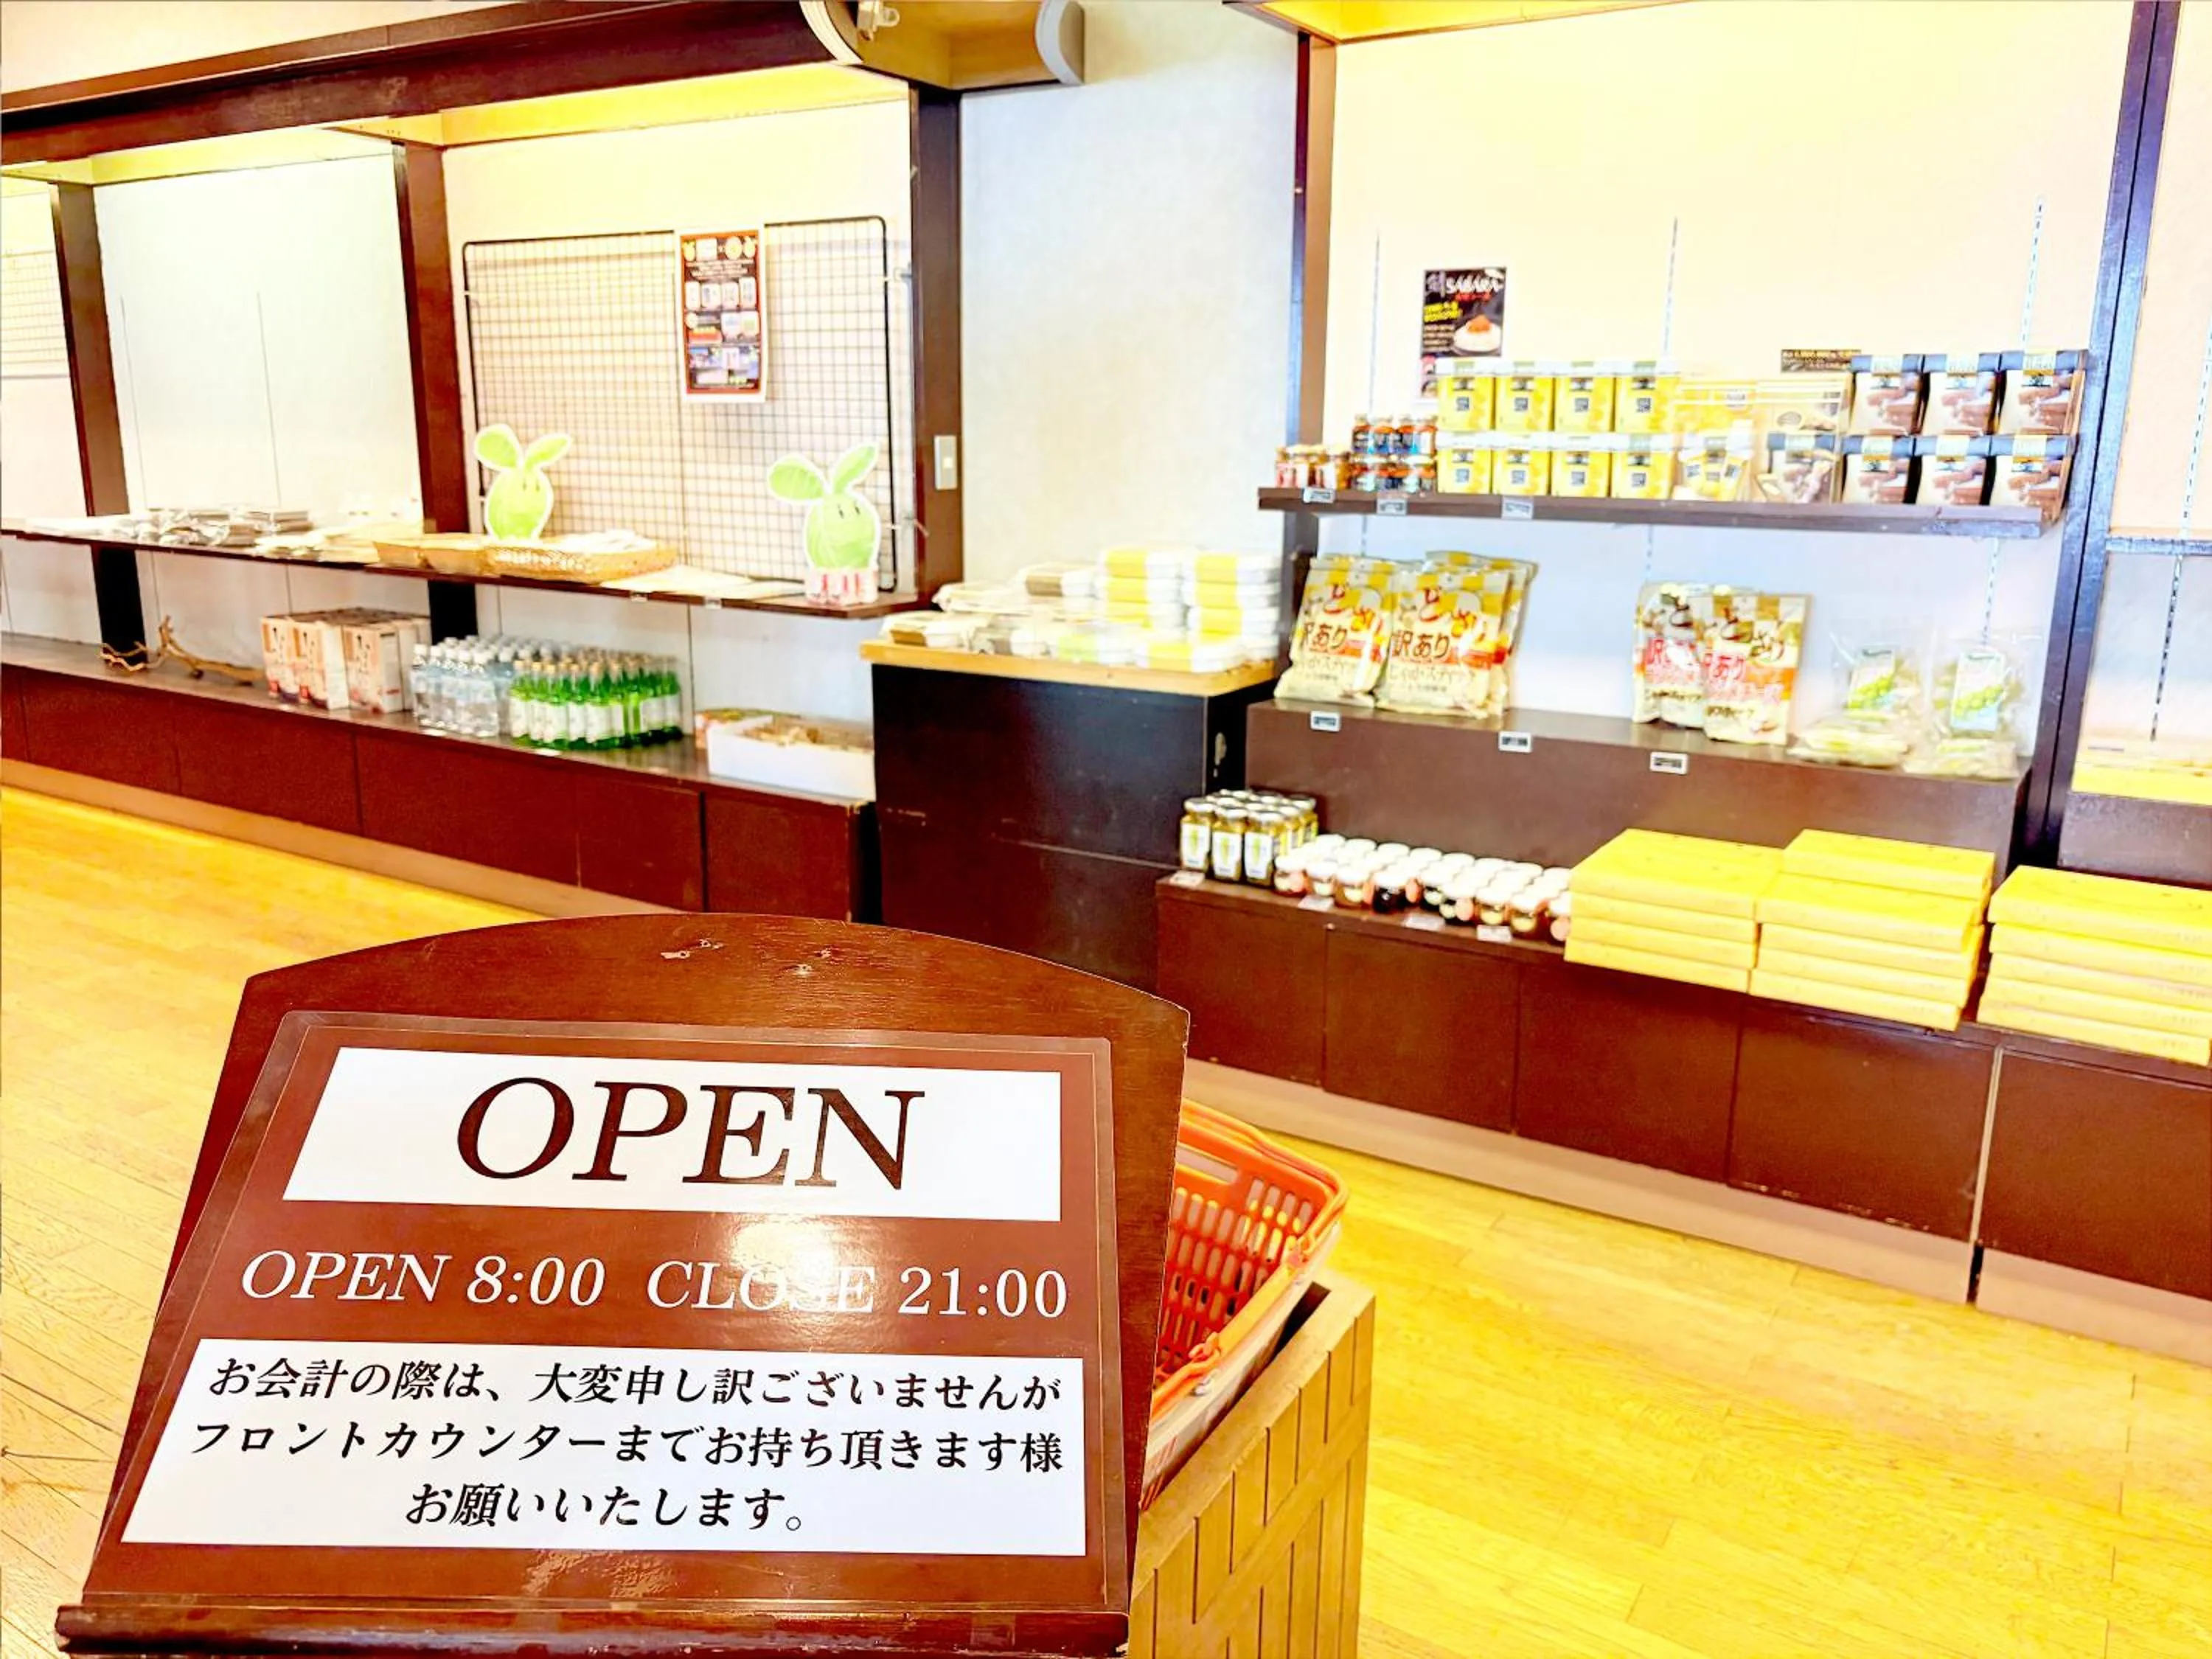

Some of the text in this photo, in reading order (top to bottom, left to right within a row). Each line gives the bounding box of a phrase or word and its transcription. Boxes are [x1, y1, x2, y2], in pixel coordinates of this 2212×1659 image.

[1391, 630, 1450, 658] 訳あり
[457, 1077, 925, 1189] OPEN
[241, 1250, 452, 1301] OPEN
[466, 1256, 605, 1306] 8:00
[898, 1266, 1068, 1318] 21:00
[209, 1357, 1061, 1411] お会計の際は、大変申し訳ございませんが
[191, 1421, 1063, 1473] フロントカウンターまでお持ち頂きます様
[406, 1482, 801, 1531] お願いいたします。
